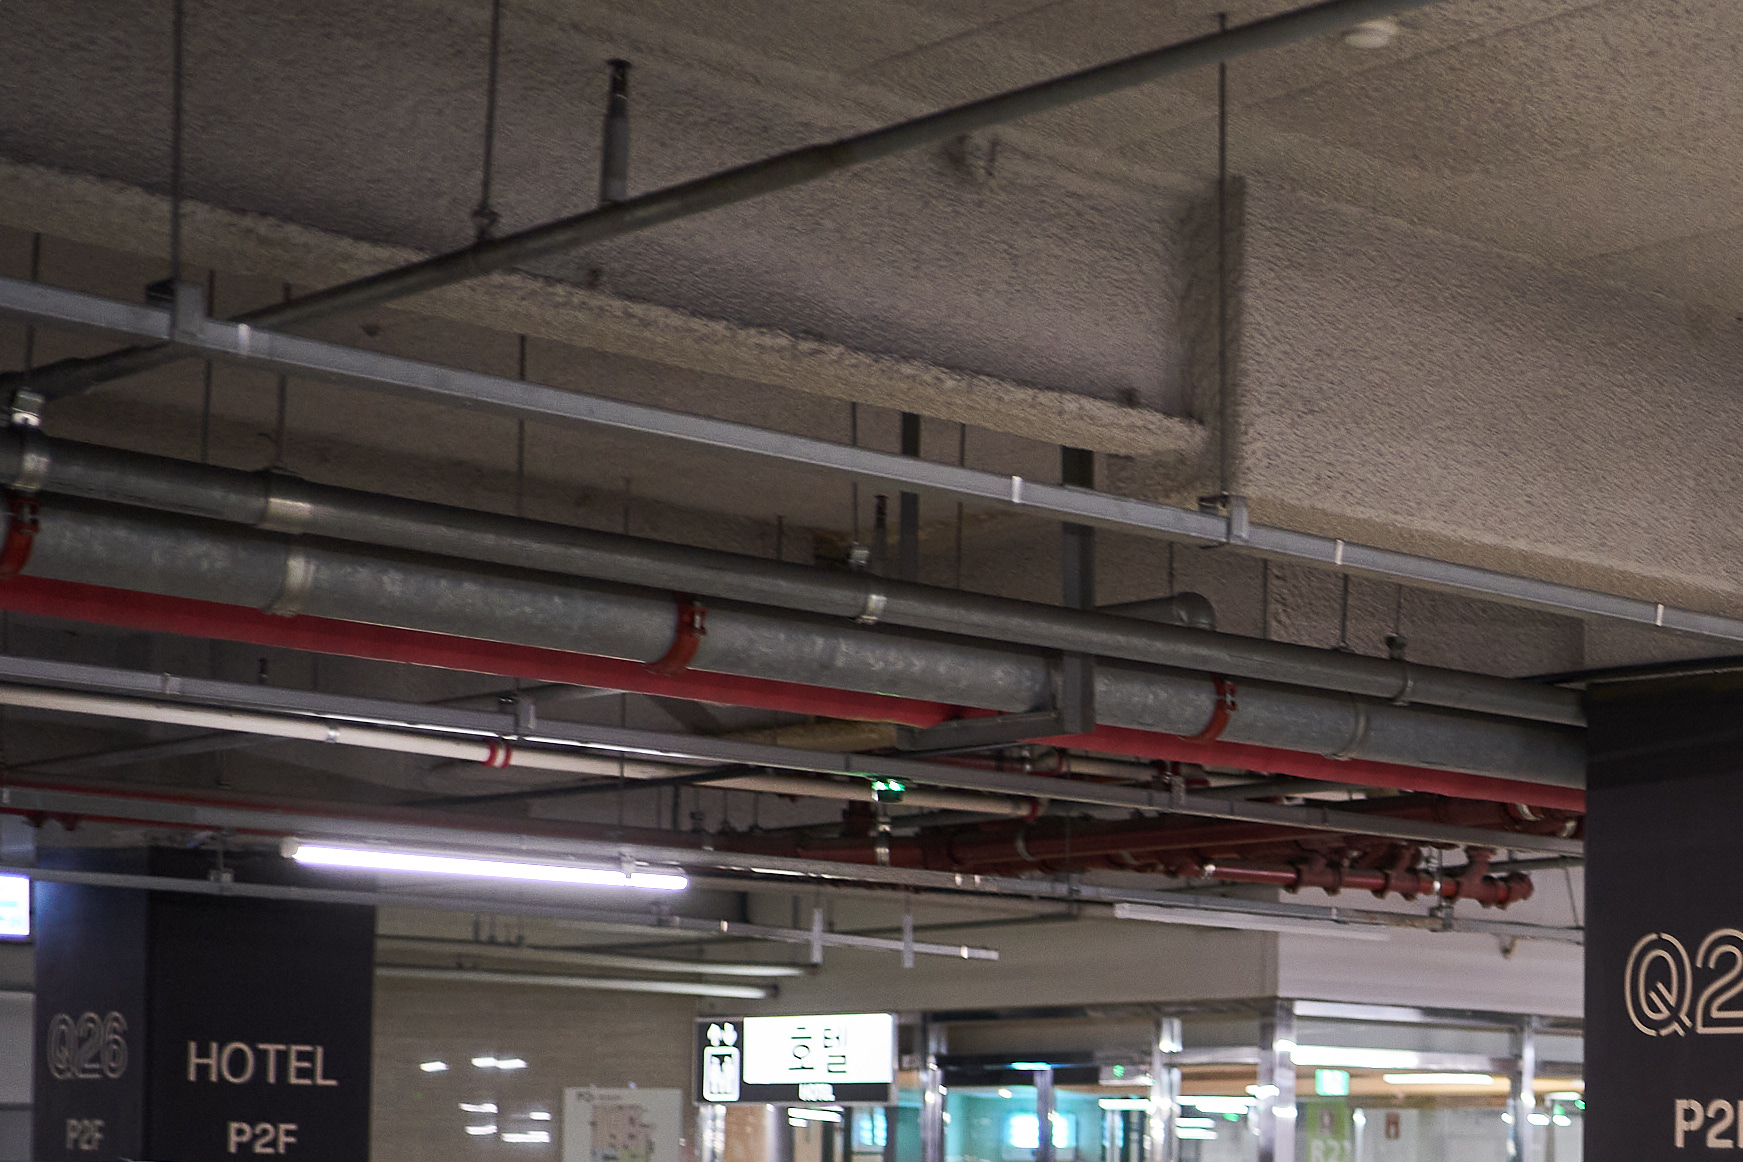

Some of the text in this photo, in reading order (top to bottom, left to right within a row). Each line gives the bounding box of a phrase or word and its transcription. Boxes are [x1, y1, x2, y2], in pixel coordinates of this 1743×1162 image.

[46, 1010, 129, 1081] Q26
[186, 1040, 339, 1087] HOTEL
[788, 1026, 848, 1074] 호텔
[65, 1118, 105, 1151] P2F
[226, 1121, 299, 1155] P2F
